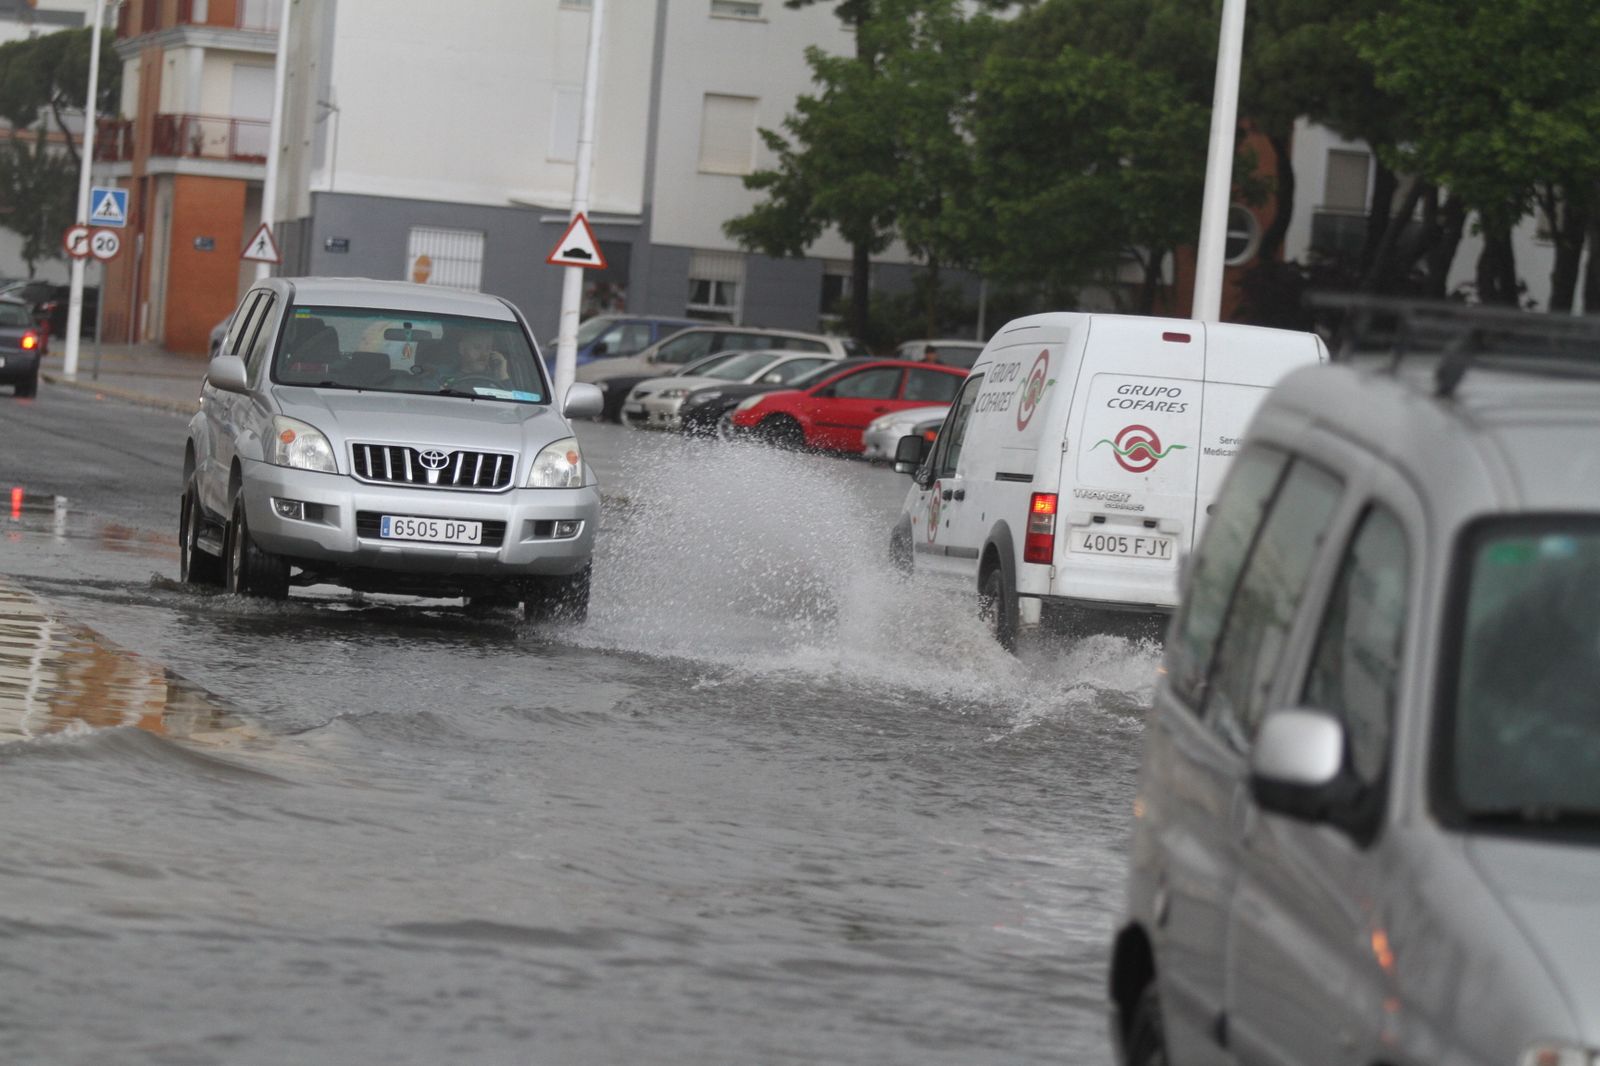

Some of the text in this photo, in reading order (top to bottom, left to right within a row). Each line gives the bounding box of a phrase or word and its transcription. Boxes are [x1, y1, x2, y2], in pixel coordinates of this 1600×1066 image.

[96, 237, 116, 251] 20
[989, 362, 1021, 383] GRUPO
[1117, 384, 1182, 398] GRUPO
[1107, 398, 1188, 413] COFARES
[1073, 488, 1131, 503] TRANSIT
[394, 519, 478, 541] 6505 DPJ
[1083, 534, 1168, 557] 4005 FJY
